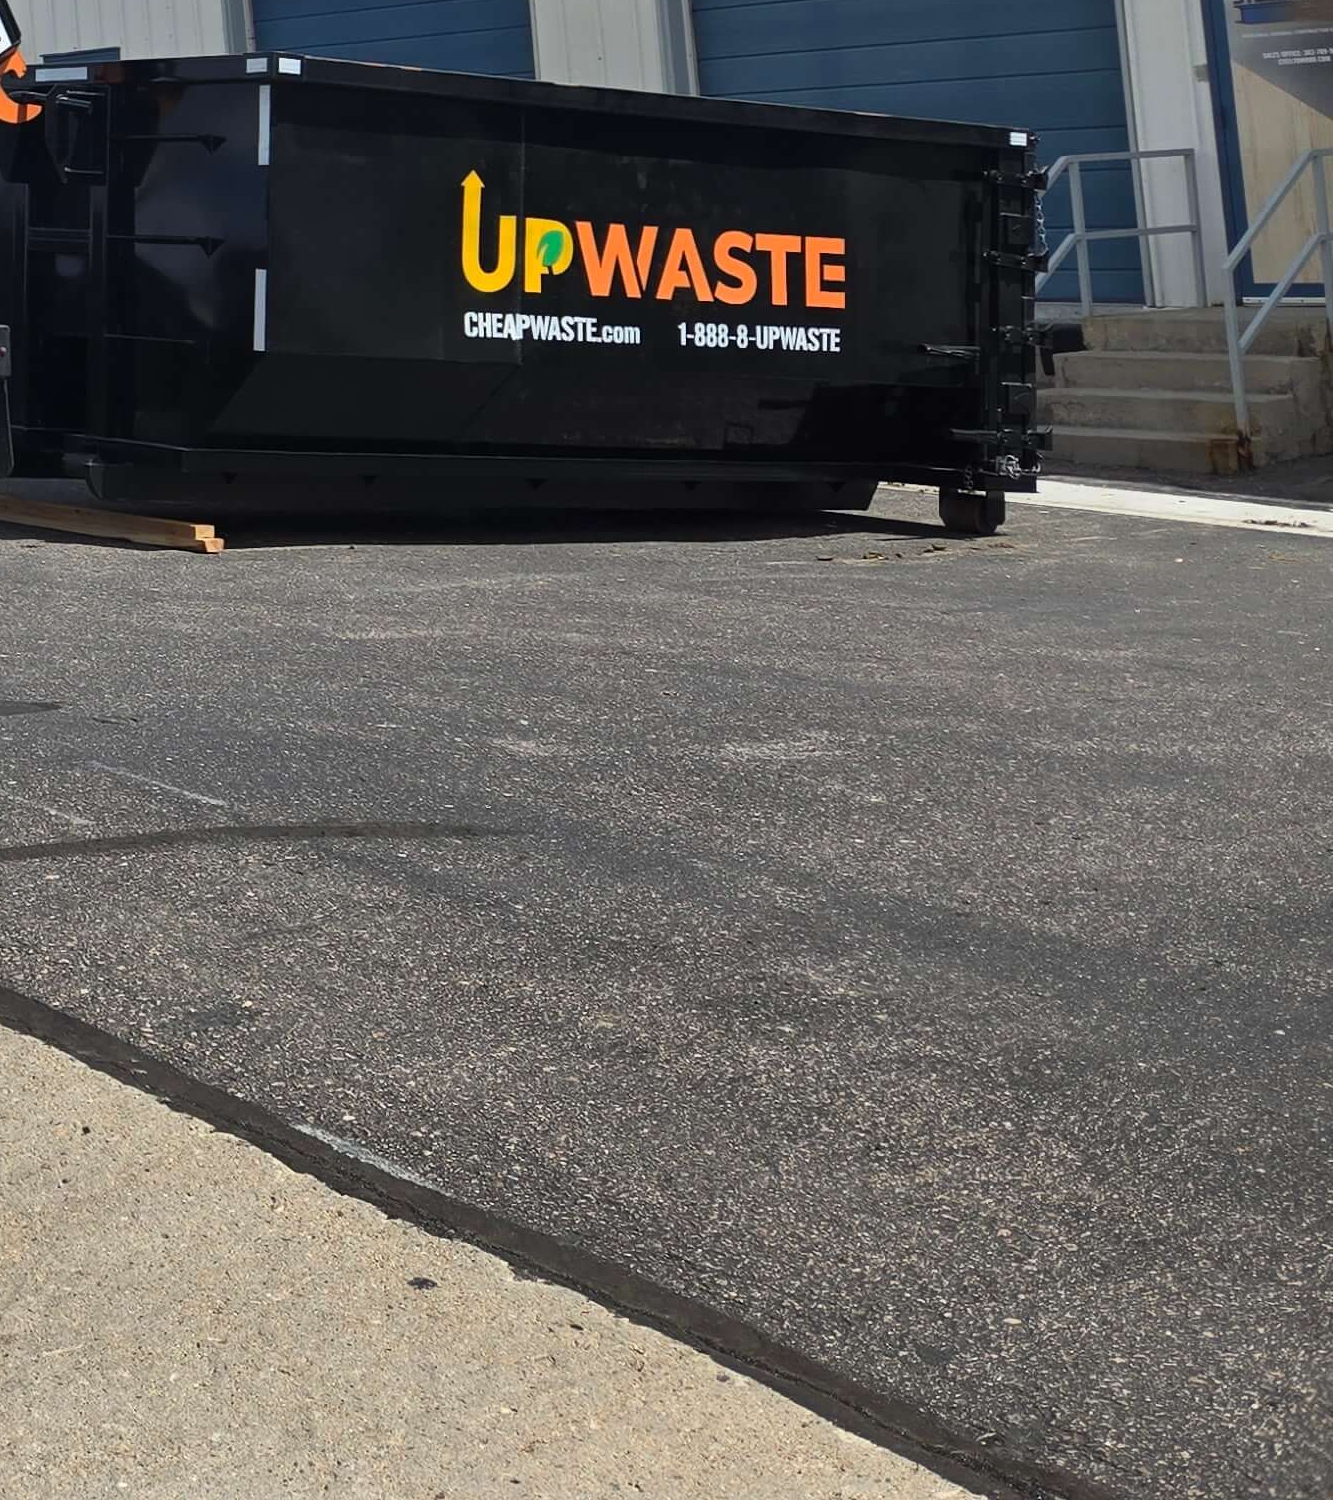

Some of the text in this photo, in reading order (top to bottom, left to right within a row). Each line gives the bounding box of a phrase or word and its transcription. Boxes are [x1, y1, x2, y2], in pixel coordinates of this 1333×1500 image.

[461, 169, 846, 309] UPWASTE
[464, 311, 841, 353] CHEAPWASTE.com 1-888-8-UPWASTE
